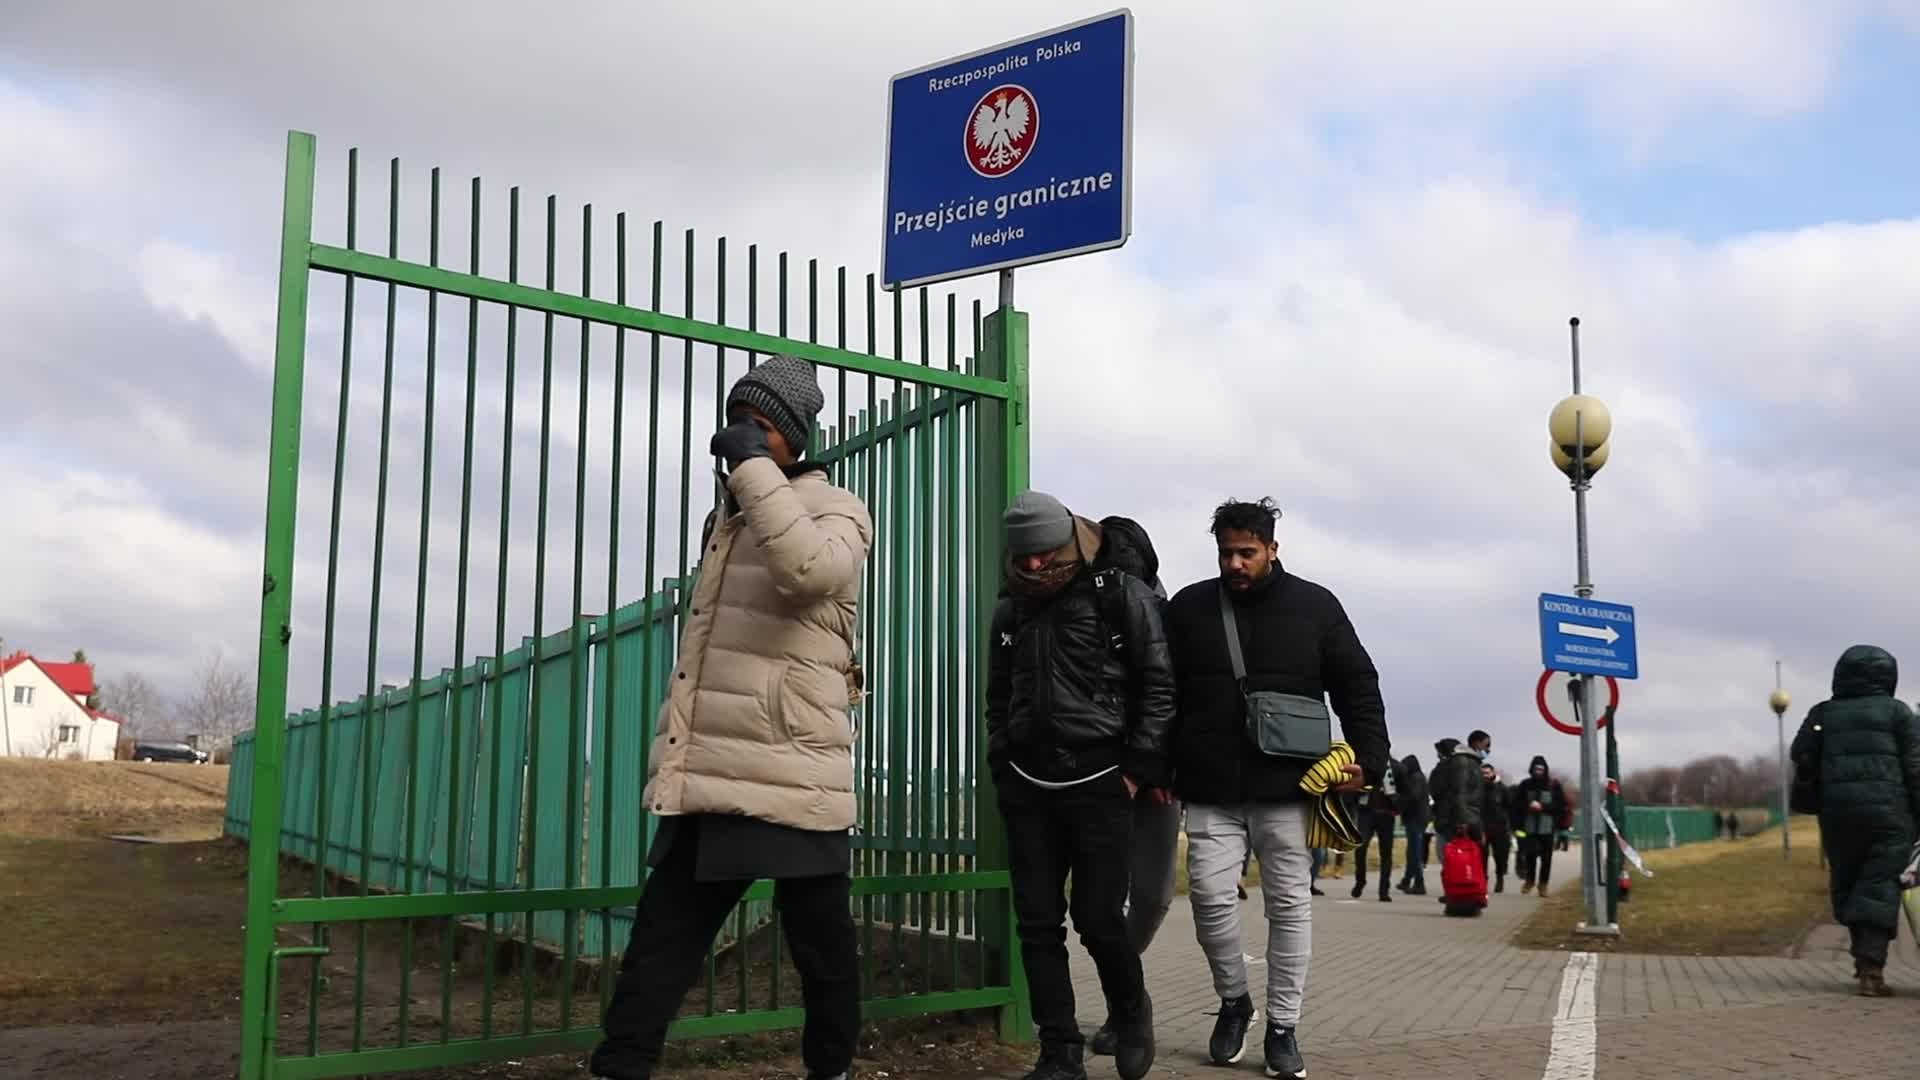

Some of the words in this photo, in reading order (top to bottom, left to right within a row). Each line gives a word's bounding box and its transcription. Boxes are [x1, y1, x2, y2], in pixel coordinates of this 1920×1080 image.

[929, 55, 1028, 92] Rzeczpospolita
[1036, 40, 1081, 62] Polska
[894, 197, 988, 234] Przejście
[994, 172, 1113, 218] graniczne
[971, 226, 1024, 248] Medyka
